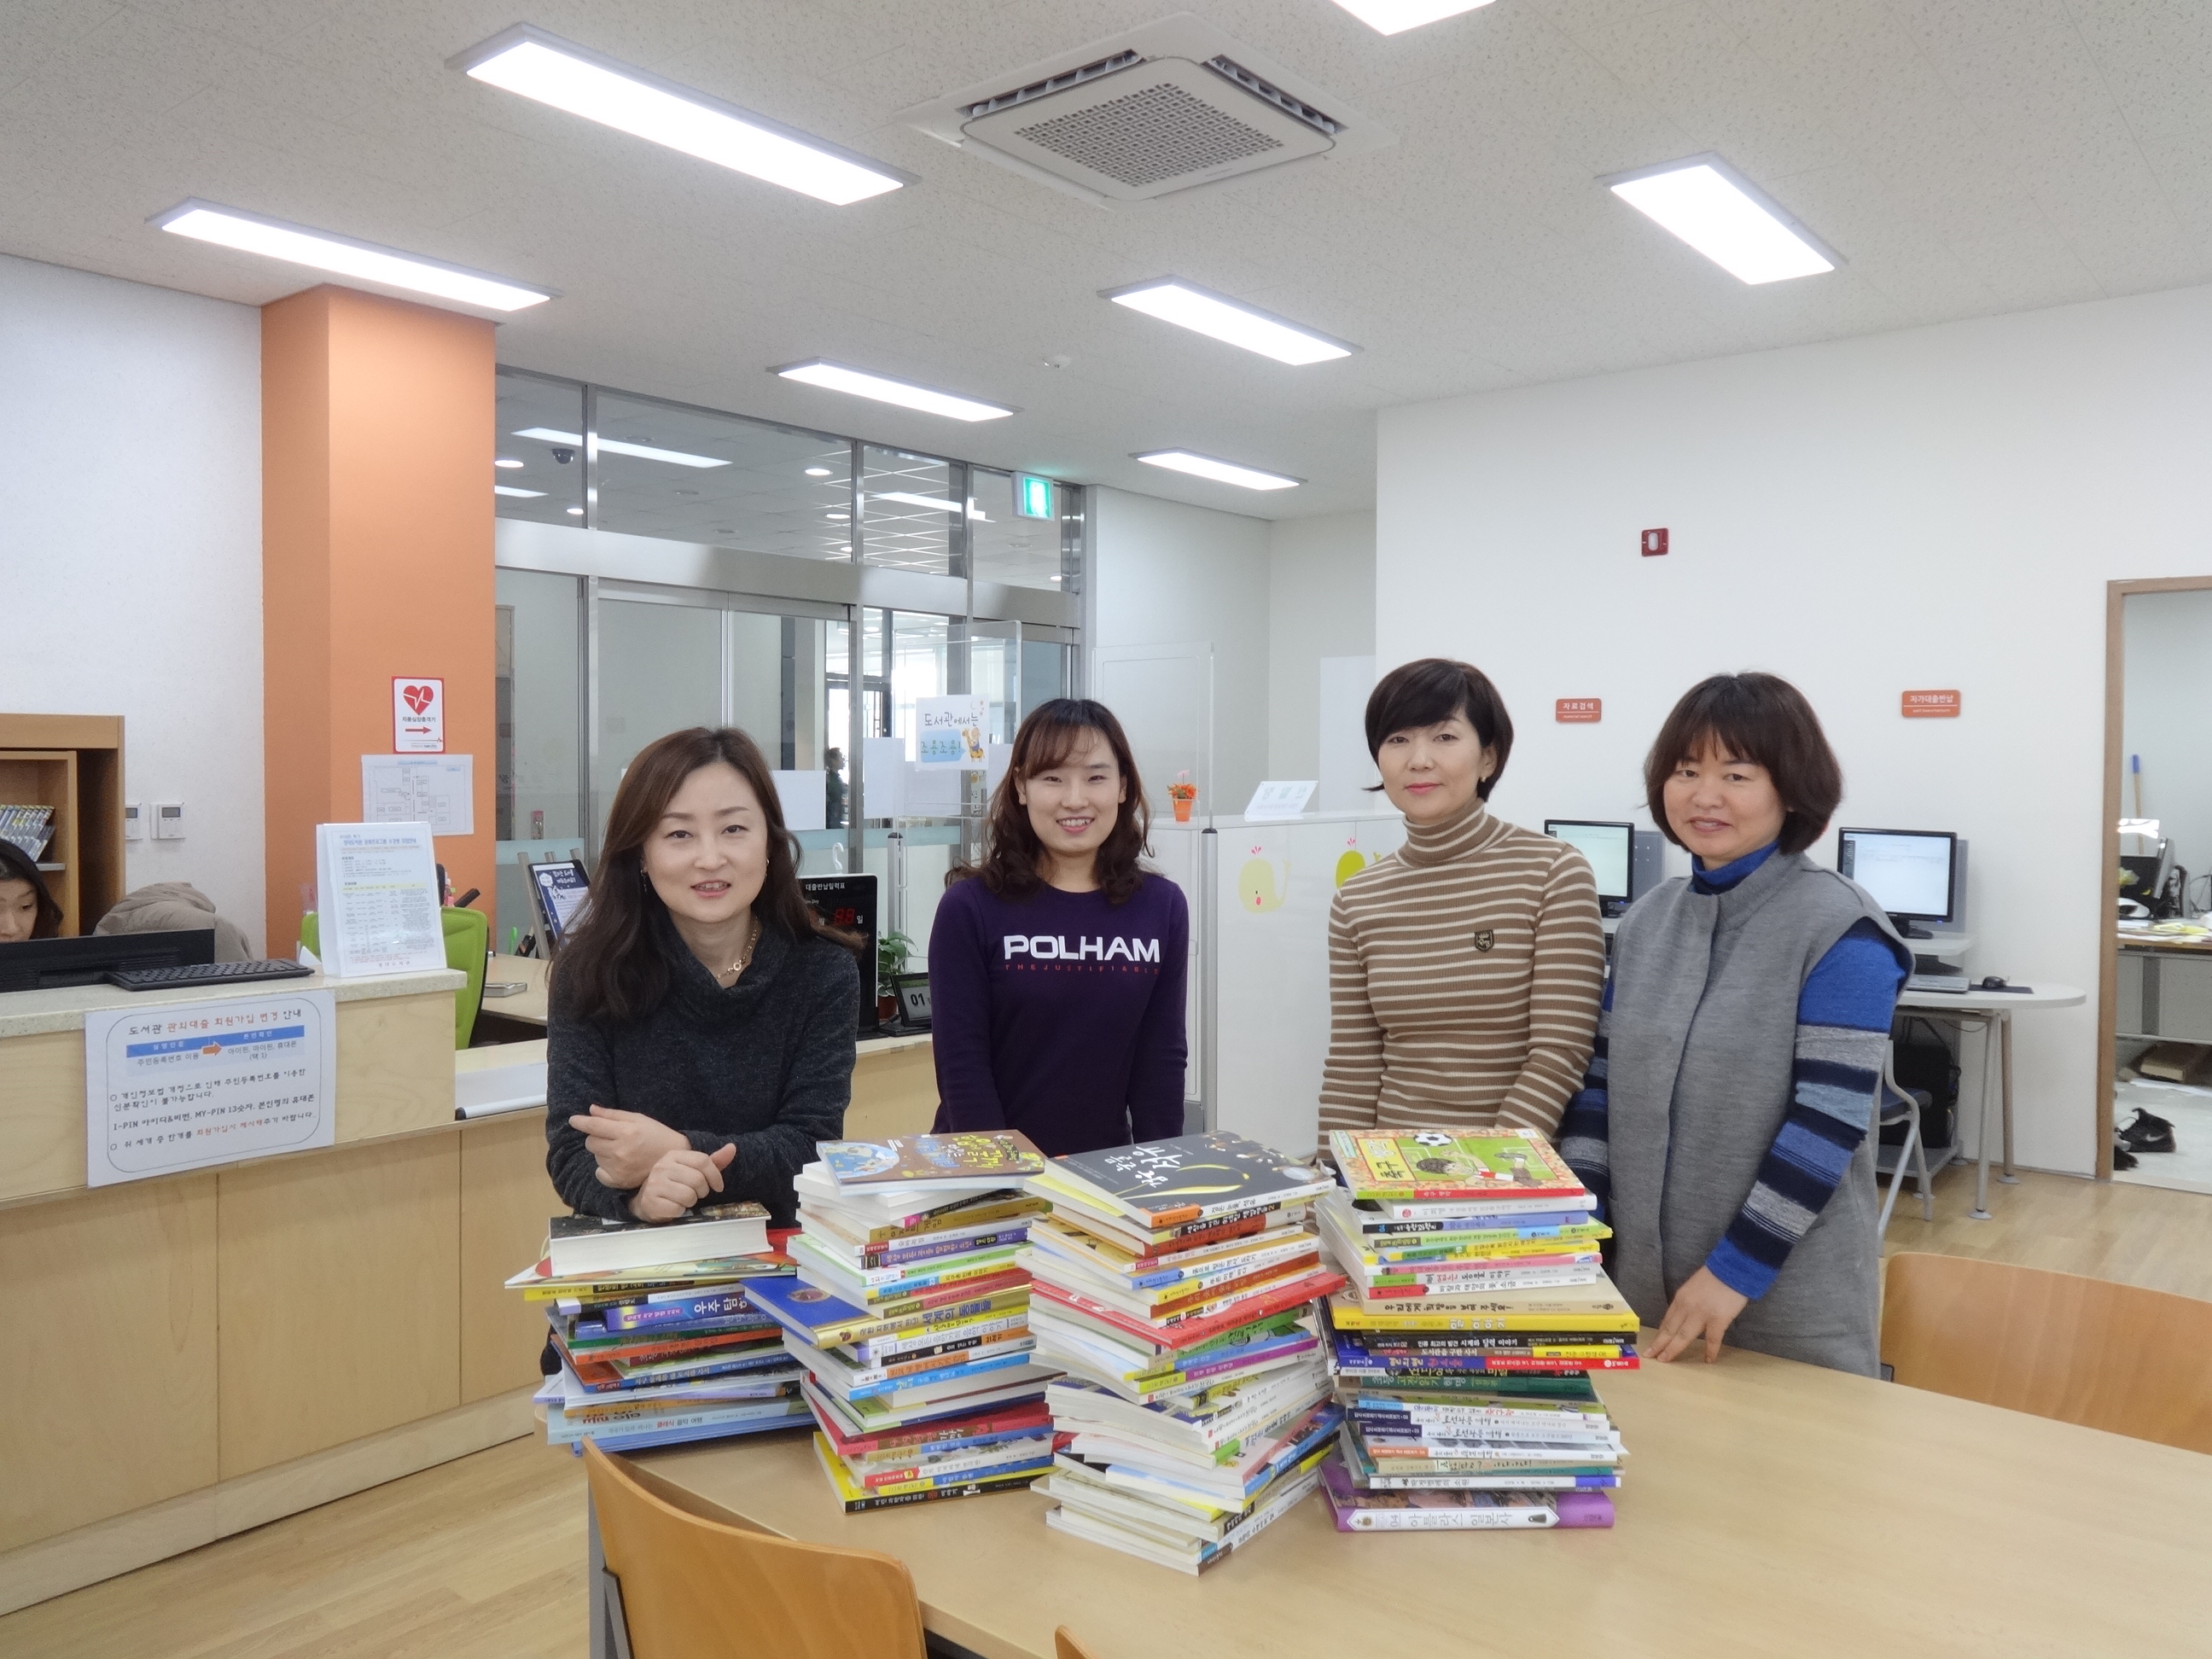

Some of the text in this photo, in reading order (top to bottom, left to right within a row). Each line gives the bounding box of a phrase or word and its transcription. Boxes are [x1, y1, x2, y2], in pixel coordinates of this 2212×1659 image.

[1910, 694, 1953, 704] 자가대출반납
[923, 712, 979, 727] 도서관에서는
[921, 739, 961, 755] 조용조용!
[856, 915, 864, 924] 일
[1004, 934, 1161, 963] POLHAM
[910, 992, 926, 1006] 01
[129, 1023, 162, 1035] 도서관
[214, 1014, 254, 1027] 회원가입
[259, 1011, 278, 1022] 변경
[282, 1009, 301, 1020] 안내
[277, 1040, 297, 1049] 휴대폰
[137, 1052, 199, 1066] 주민등록번호 이용
[114, 1121, 138, 1131] I-PIN
[195, 1108, 225, 1119] MY-PIN
[292, 1093, 315, 1103] 휴대폰
[1268, 1202, 1275, 1212] 2
[1462, 1271, 1486, 1281] 동물
[1488, 1270, 1511, 1279] 이야기
[1439, 1284, 1462, 1293] 바람과
[1464, 1282, 1487, 1292] 태양의
[1499, 1280, 1516, 1289] 소금
[694, 1299, 720, 1315] 우주
[1384, 1303, 1422, 1313] 우리에게
[1460, 1303, 1477, 1312] 보여
[859, 1326, 874, 1336] 극한
[922, 1307, 955, 1324] 세계의
[958, 1299, 992, 1317] 동물들
[1449, 1317, 1506, 1330] 알 이야기
[981, 1321, 1004, 1334] 이야기
[1482, 1337, 1496, 1348] 달력
[1498, 1338, 1518, 1347] 이야기
[1421, 1348, 1448, 1357] 도서관을
[1450, 1348, 1463, 1357] 구한
[656, 1420, 675, 1429] 클래식
[1441, 1414, 1473, 1425] 조선왕릉
[1476, 1416, 1492, 1426] 여행
[1452, 1429, 1502, 1438] 조선왕릉 여행
[1389, 1511, 1513, 1528] 04 아틀라스 일본사
